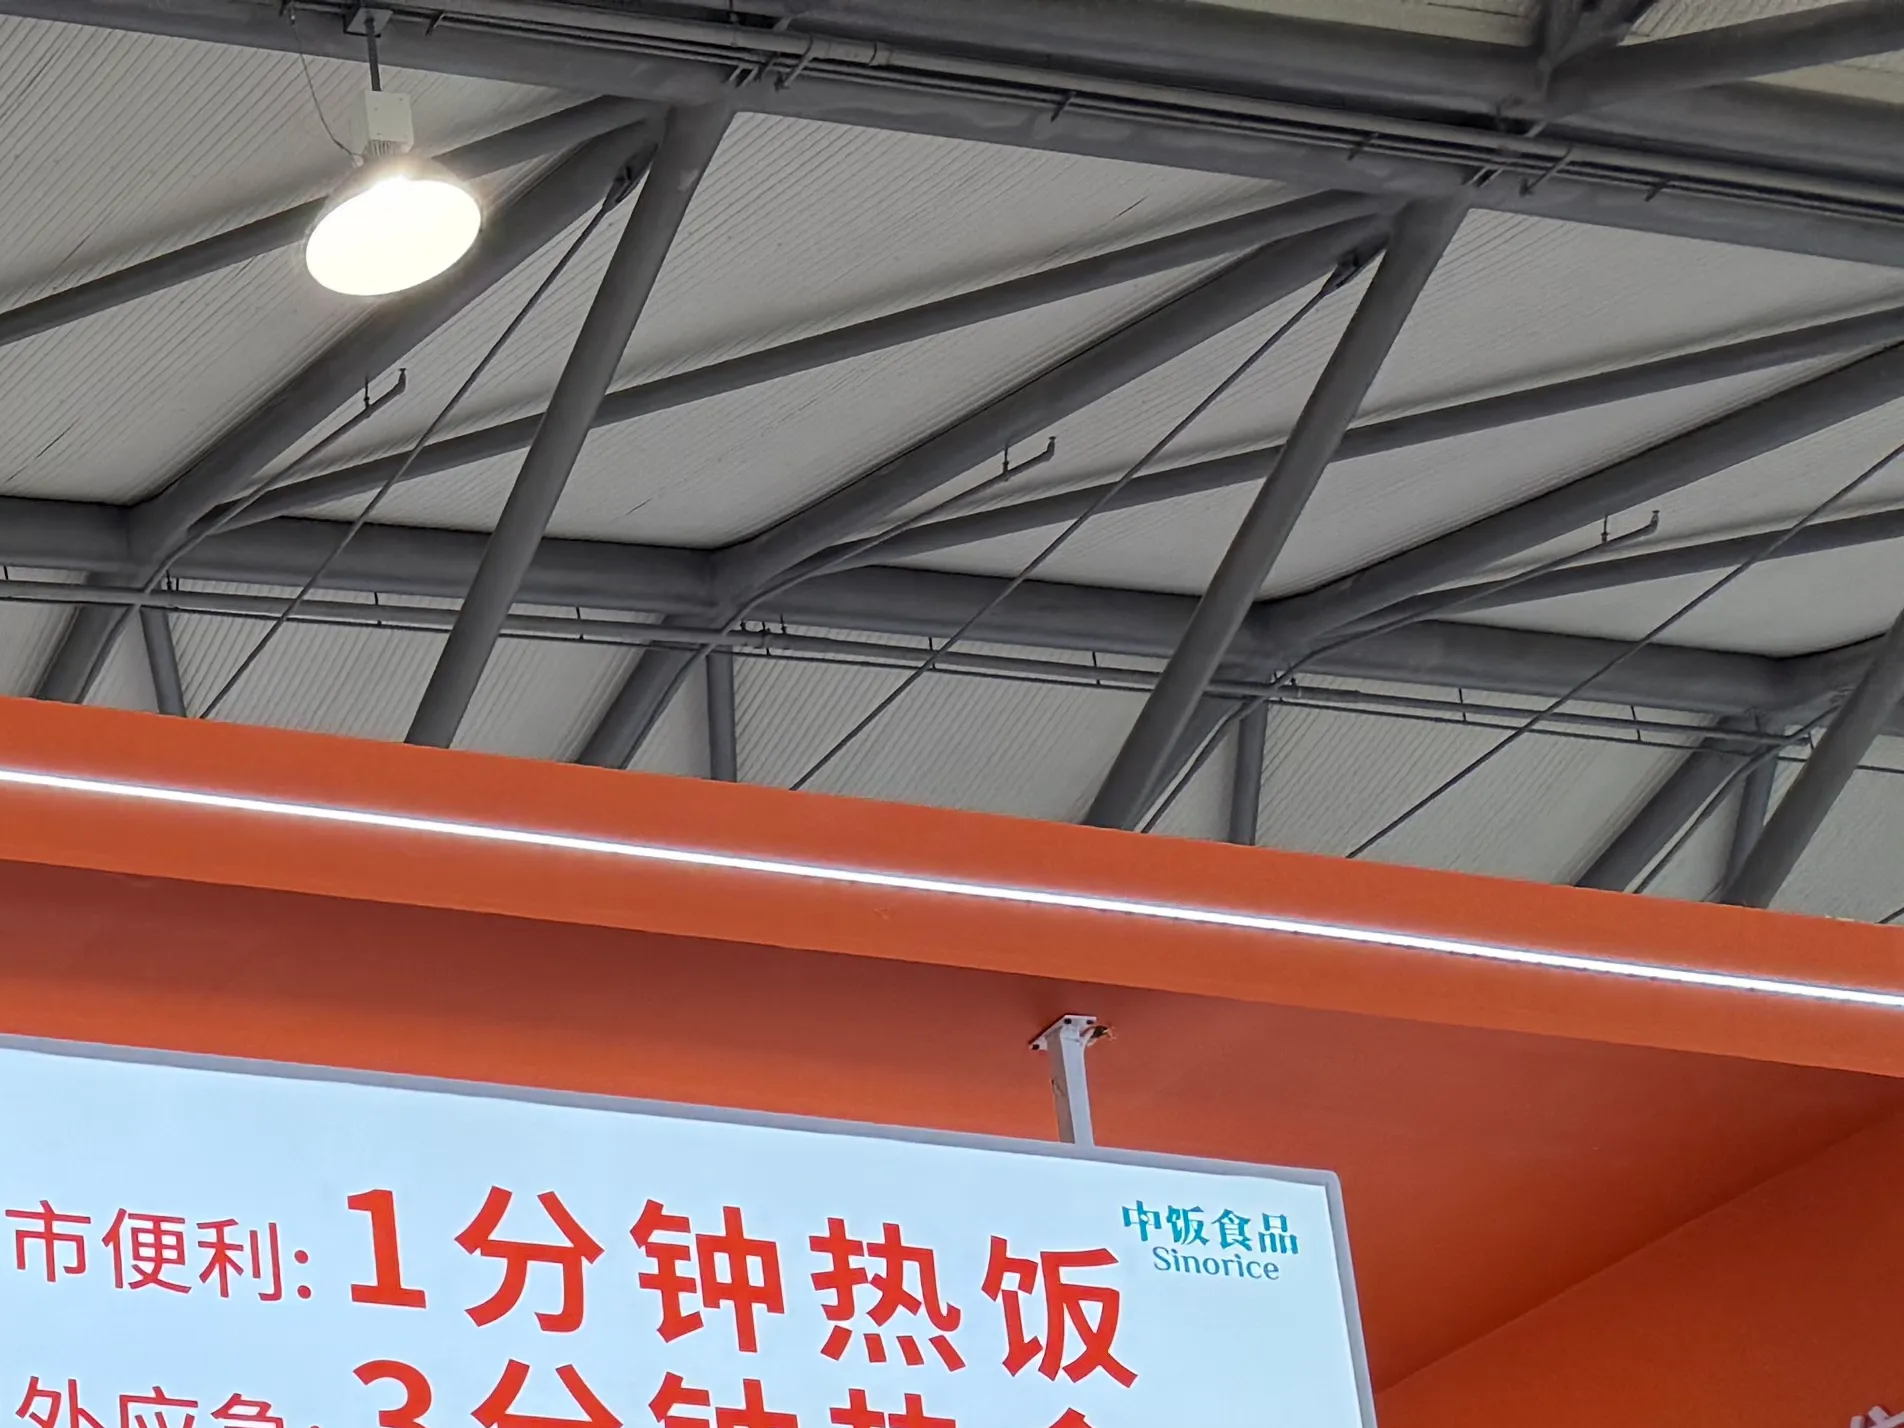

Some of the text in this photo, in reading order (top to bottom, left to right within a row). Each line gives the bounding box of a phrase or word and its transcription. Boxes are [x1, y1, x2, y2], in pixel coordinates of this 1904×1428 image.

[1121, 1200, 1300, 1256] 中饭食品
[1152, 1245, 1280, 1281] Sinorice
